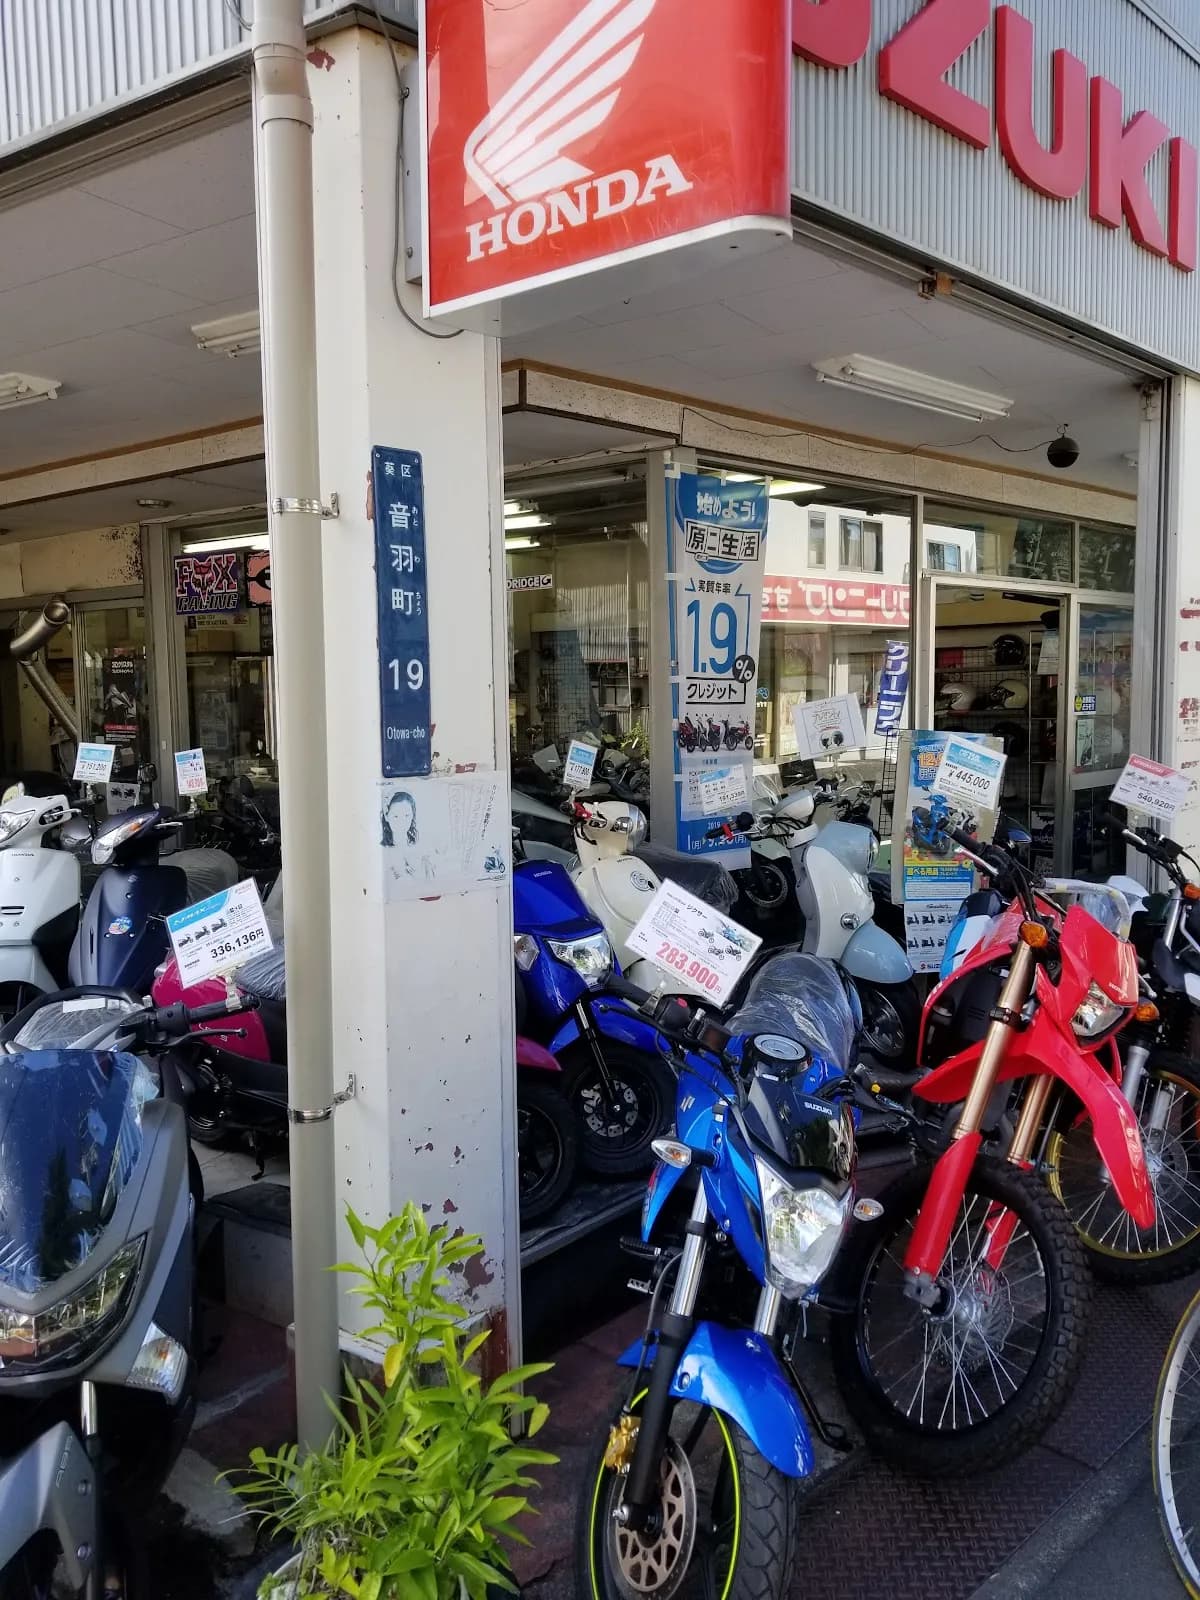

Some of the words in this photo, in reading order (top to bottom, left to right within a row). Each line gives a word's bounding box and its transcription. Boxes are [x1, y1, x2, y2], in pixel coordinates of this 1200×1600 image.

[792, 0, 1198, 272] ZUKI
[465, 154, 694, 263] HONDA
[384, 461, 412, 479] 葵区
[388, 501, 414, 616] 音羽町
[177, 592, 238, 612] RACING
[388, 658, 424, 691] 19
[687, 682, 738, 700] クレジット
[386, 725, 425, 741] Otowa-cho
[686, 904, 708, 919] ジクサー
[210, 928, 265, 959] 336,136円
[656, 941, 723, 993] 283,900円
[804, 1101, 833, 1116] SUZUKI
